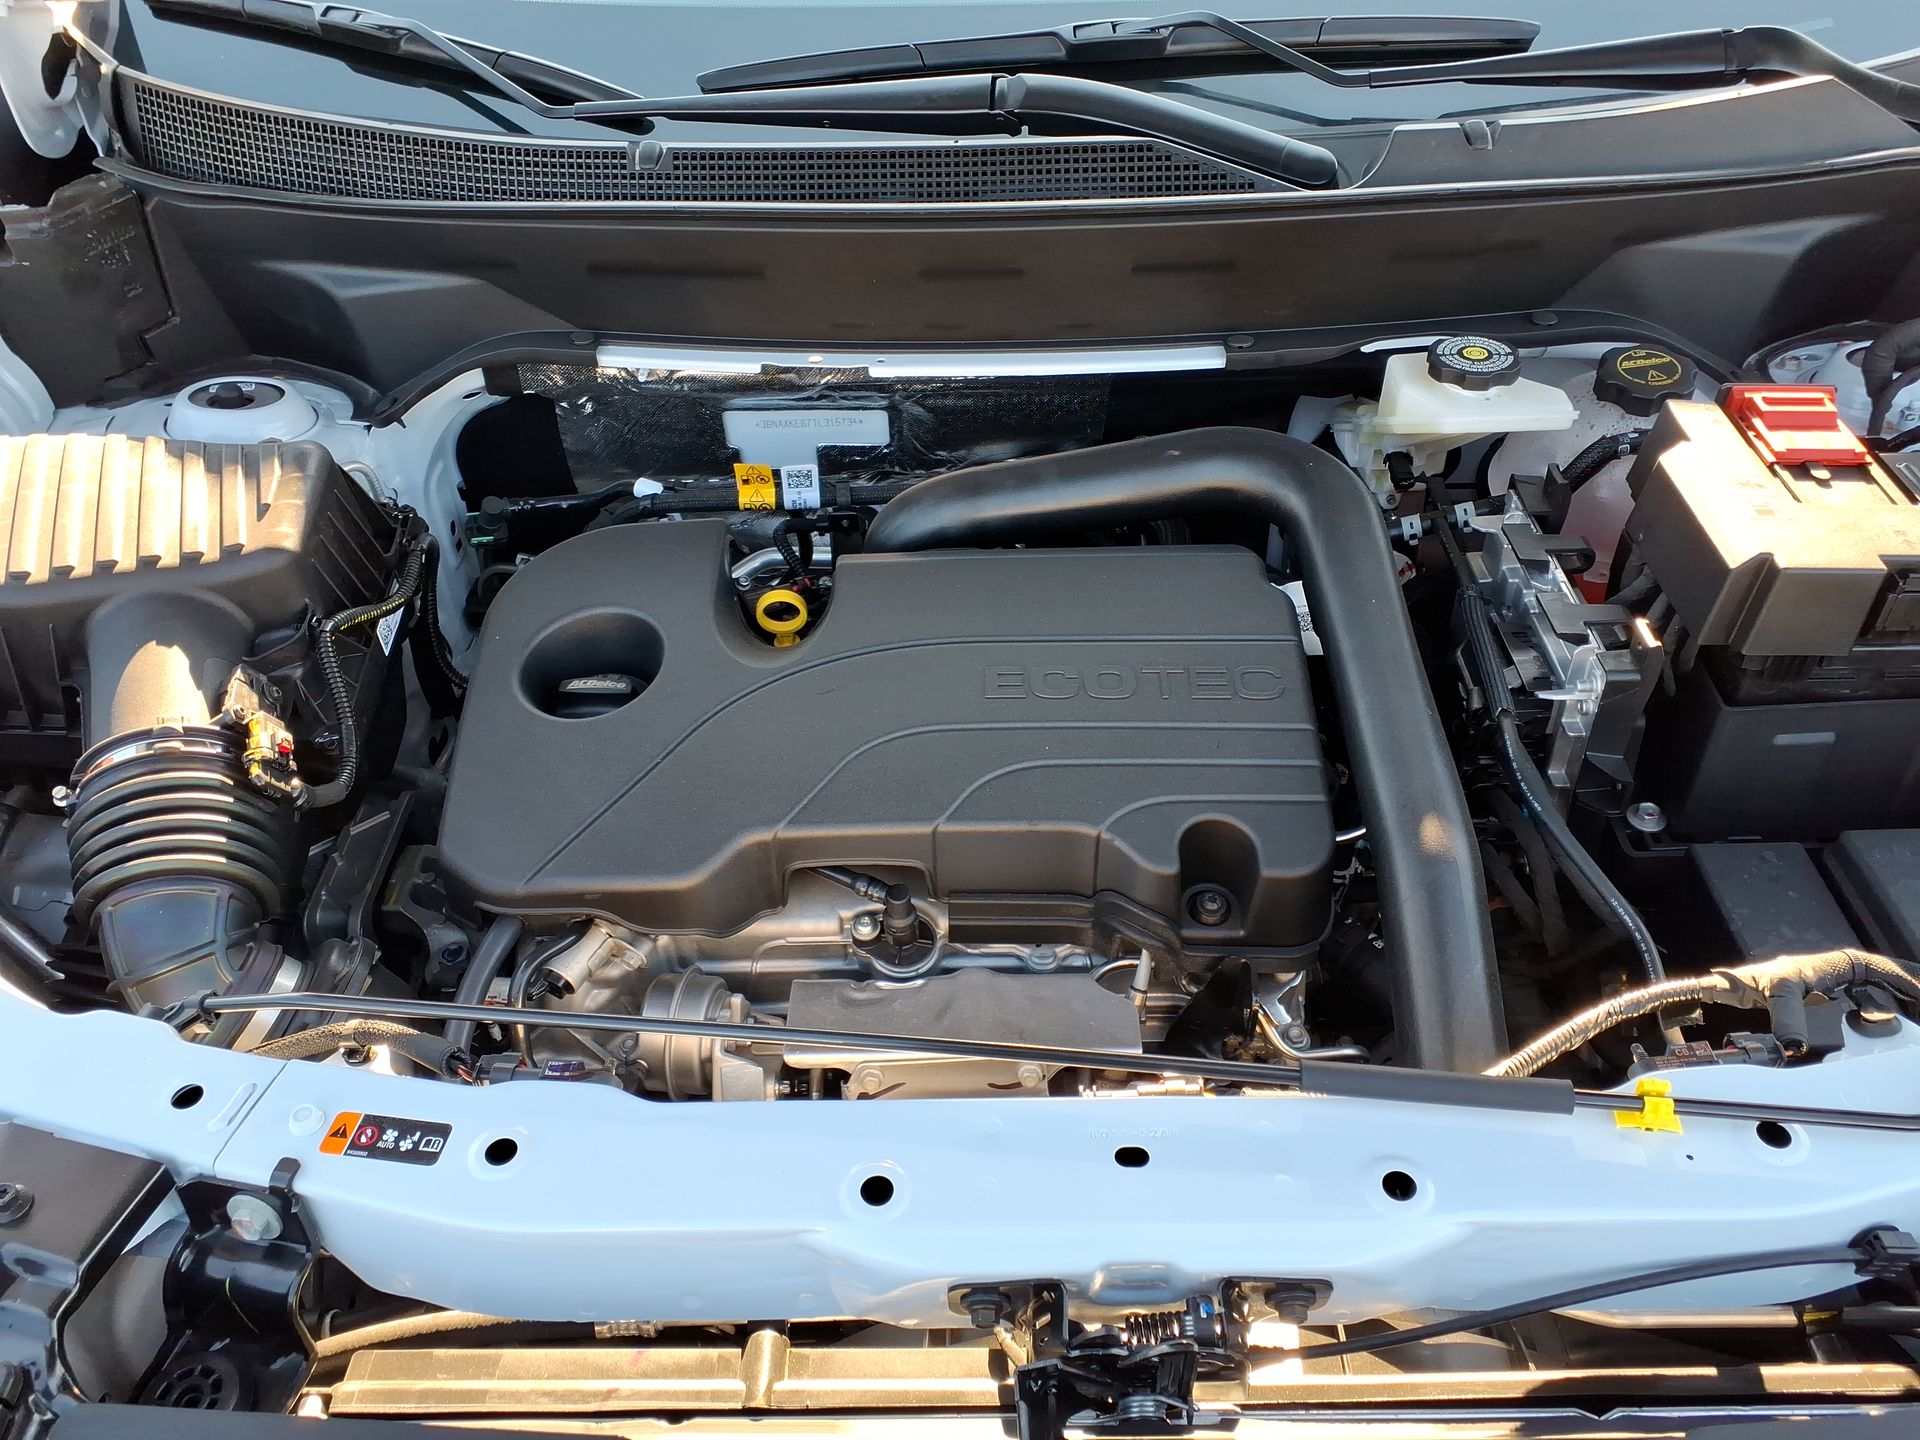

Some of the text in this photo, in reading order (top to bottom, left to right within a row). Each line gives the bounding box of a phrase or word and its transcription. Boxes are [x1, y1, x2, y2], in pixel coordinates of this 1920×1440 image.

[1620, 357, 1671, 369] ACDelco
[565, 679, 627, 690] ACDelco
[984, 665, 1286, 700] ECOTEC
[376, 1140, 395, 1149] AUTO
